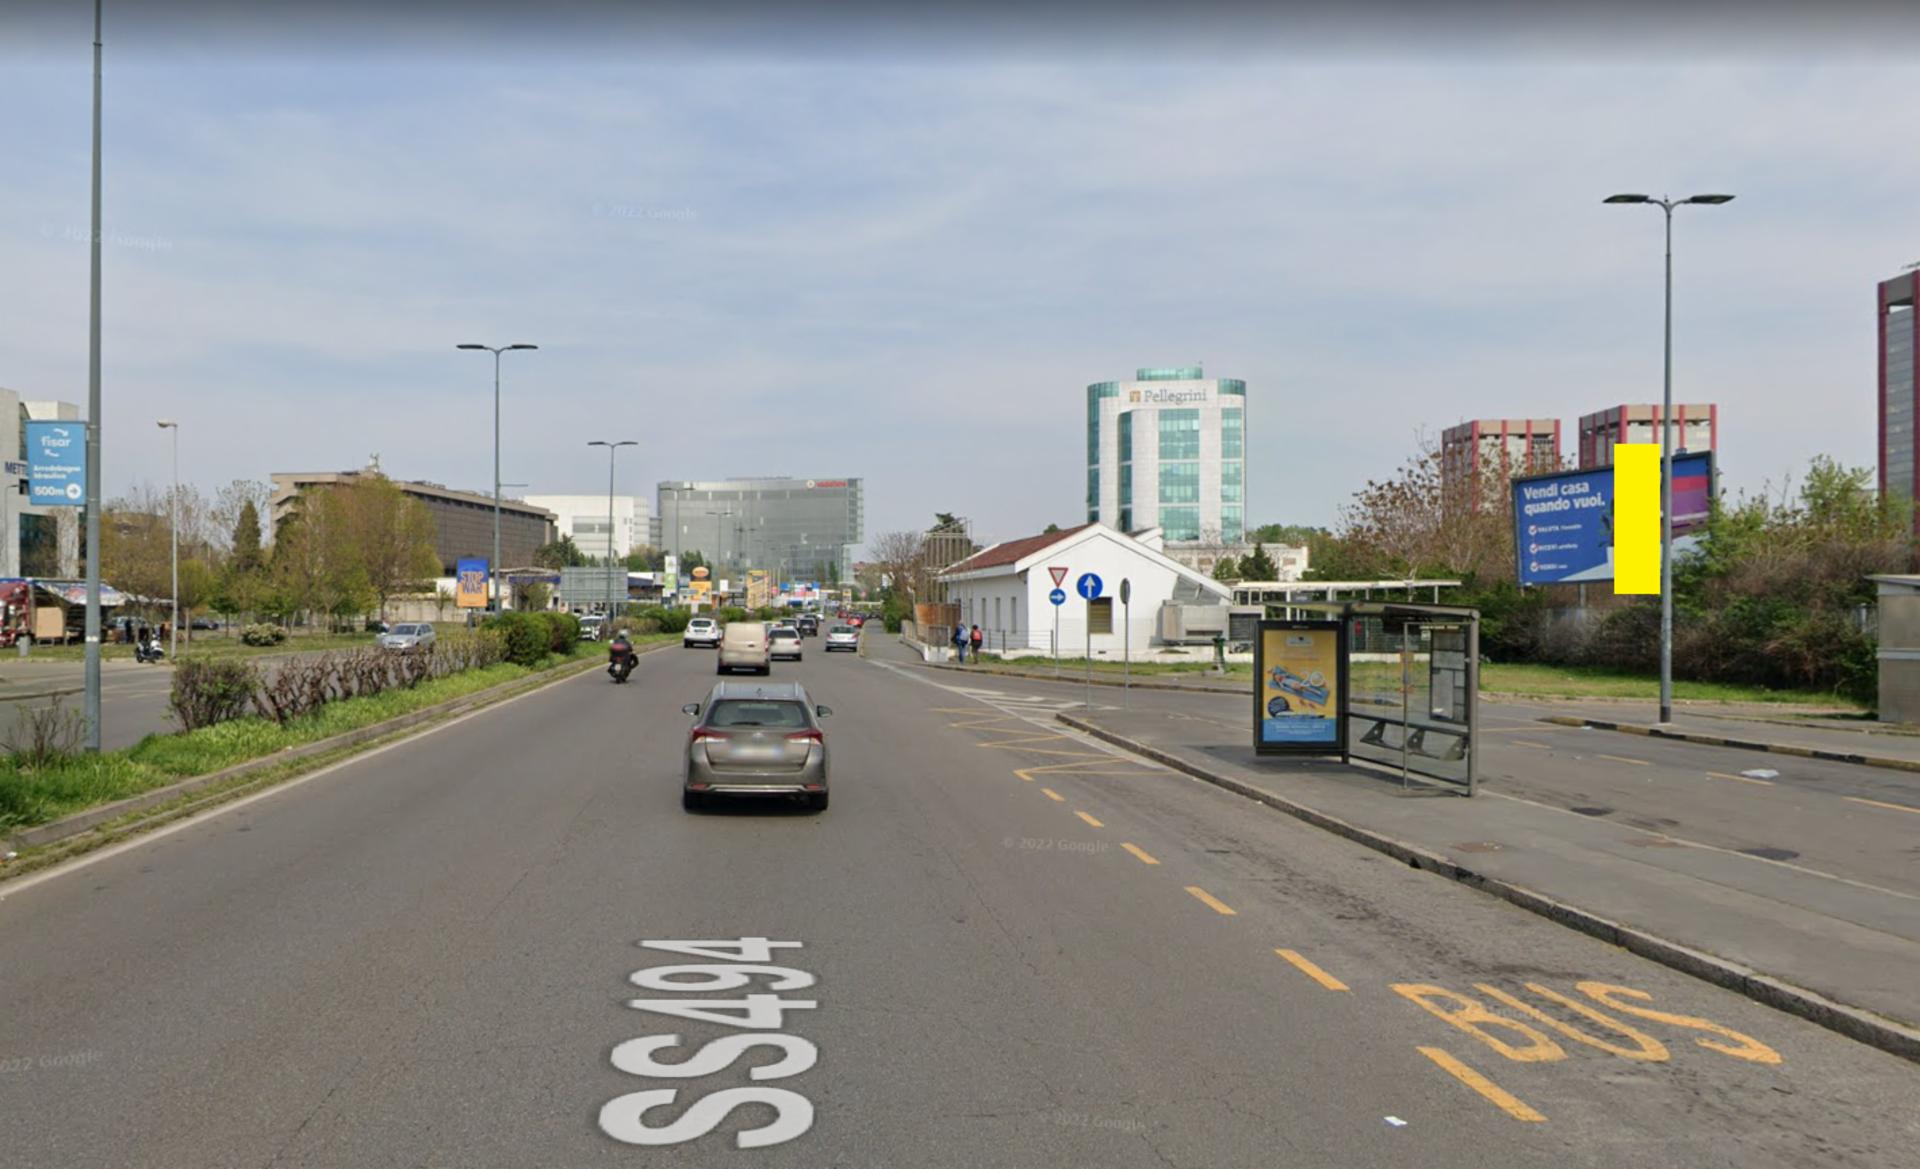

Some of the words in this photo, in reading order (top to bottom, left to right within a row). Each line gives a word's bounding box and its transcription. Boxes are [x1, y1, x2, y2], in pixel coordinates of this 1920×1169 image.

[1144, 388, 1207, 405] Pellegrini
[41, 435, 71, 447] fisar
[1523, 483, 1558, 500] Vendi
[1561, 482, 1590, 495] casa
[1524, 498, 1571, 516] quando
[1572, 492, 1605, 509] vuoi.
[460, 571, 485, 582] STOP
[462, 582, 483, 594] WAR
[1387, 981, 1785, 1064] BUS
[599, 936, 818, 1149] SS494
